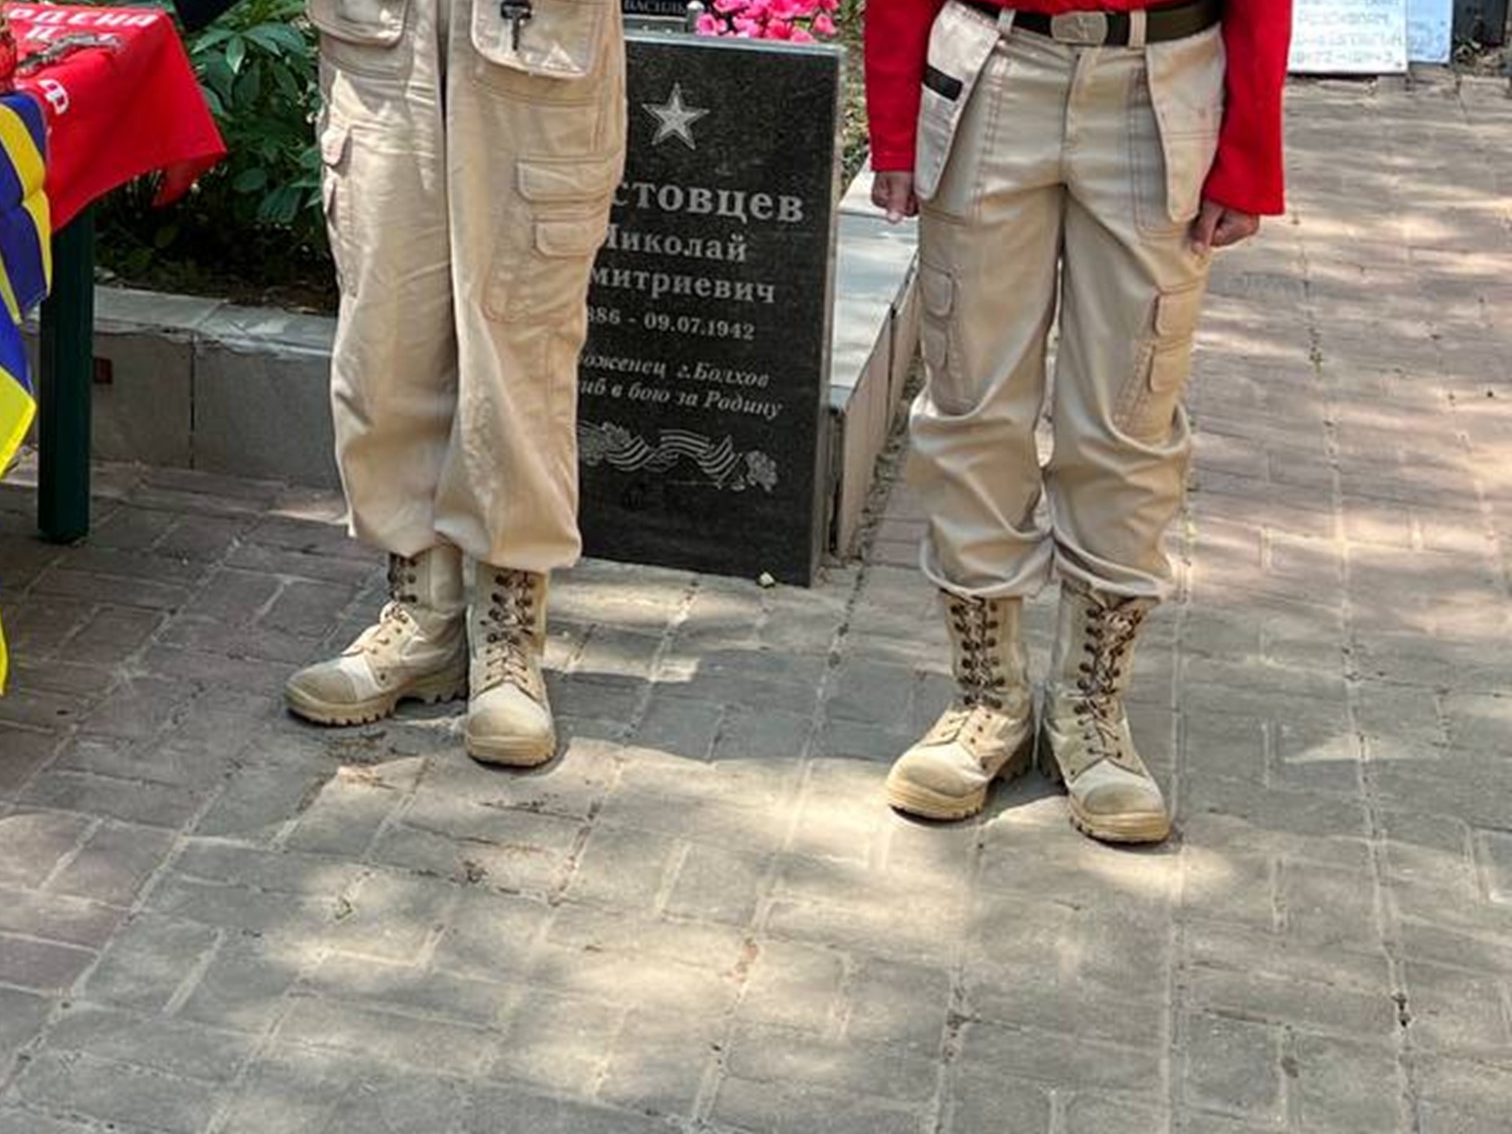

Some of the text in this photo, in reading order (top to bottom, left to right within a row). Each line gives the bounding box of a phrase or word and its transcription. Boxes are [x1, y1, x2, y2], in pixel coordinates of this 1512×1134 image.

[8, 7, 159, 28] РДЕНА
[624, 0, 687, 15] ВАСИЛЬ
[643, 311, 756, 341] 09.07.1942
[611, 384, 624, 398] в
[628, 381, 671, 403] бою
[676, 390, 699, 408] за
[703, 390, 783, 421] Родину
